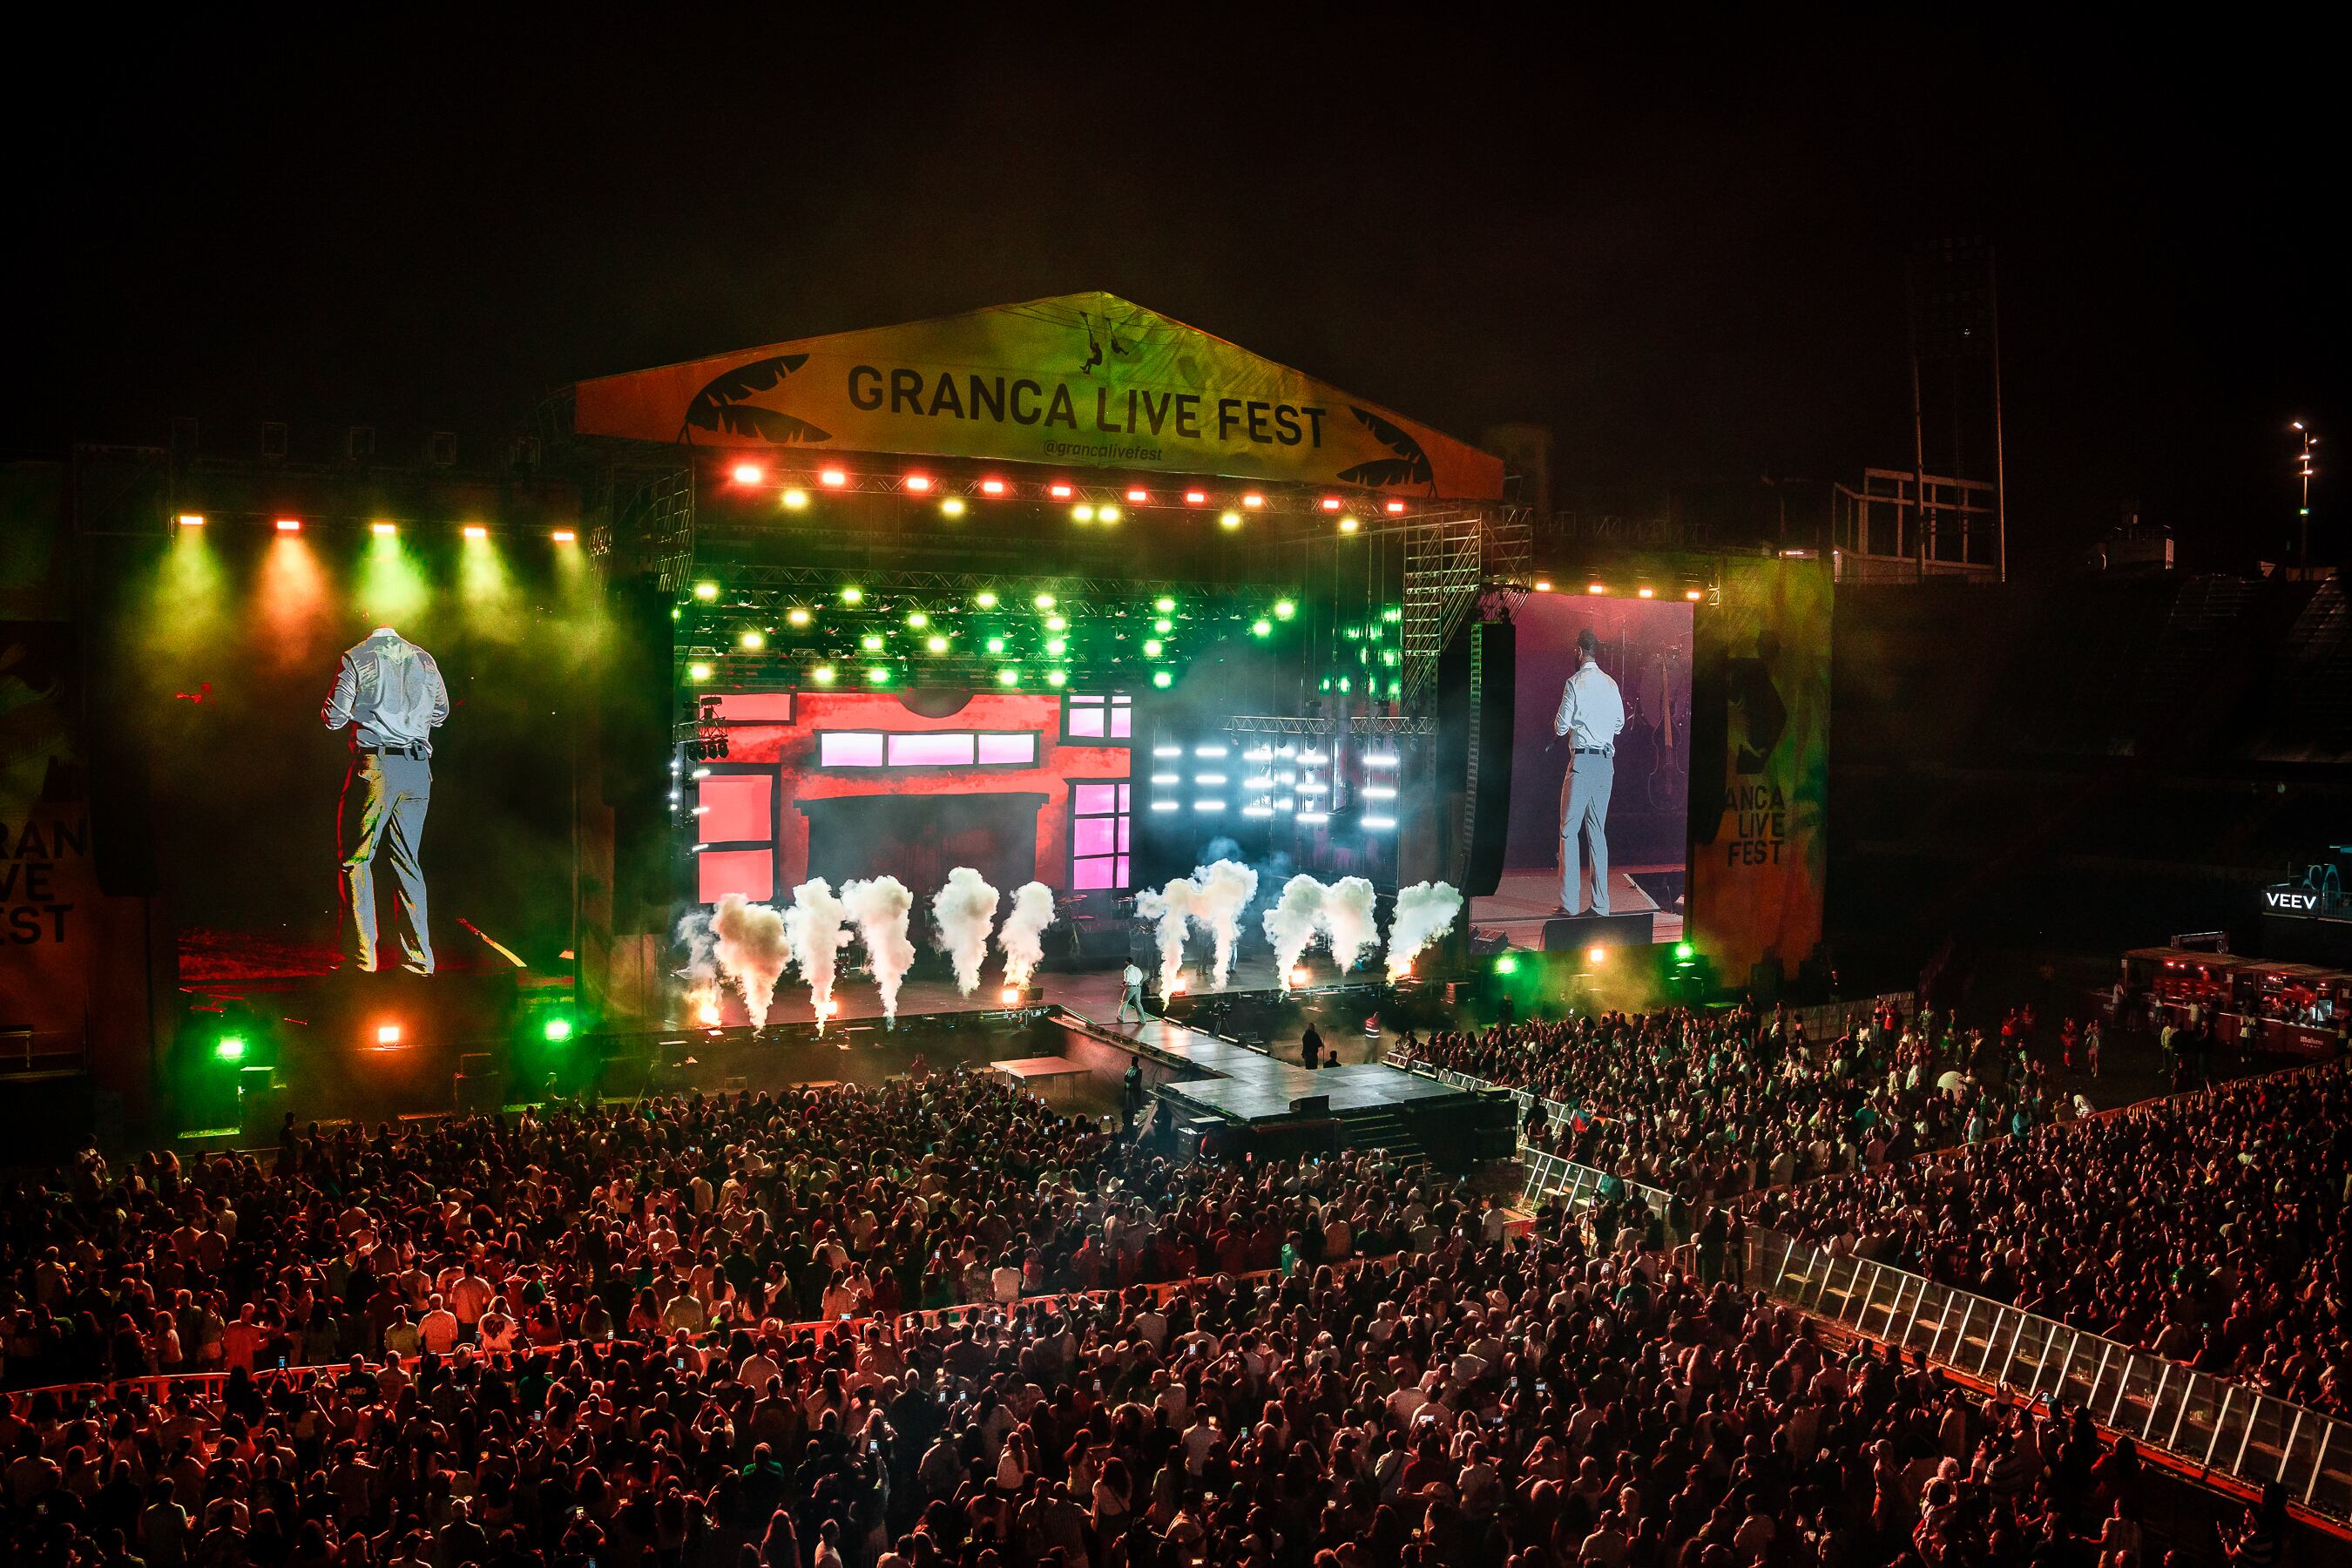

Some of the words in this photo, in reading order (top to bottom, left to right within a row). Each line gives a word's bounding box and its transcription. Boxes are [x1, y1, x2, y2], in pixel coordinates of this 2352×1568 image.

[848, 365, 1077, 430] GRANCA
[1096, 388, 1201, 438] LIVE
[1218, 398, 1326, 449] FEST
[1044, 439, 1164, 461] @grancalivefest
[1739, 811, 1786, 838] LIVE
[1728, 840, 1784, 867] FEST
[2266, 892, 2317, 909] VEEV
[0, 903, 74, 944] ST
